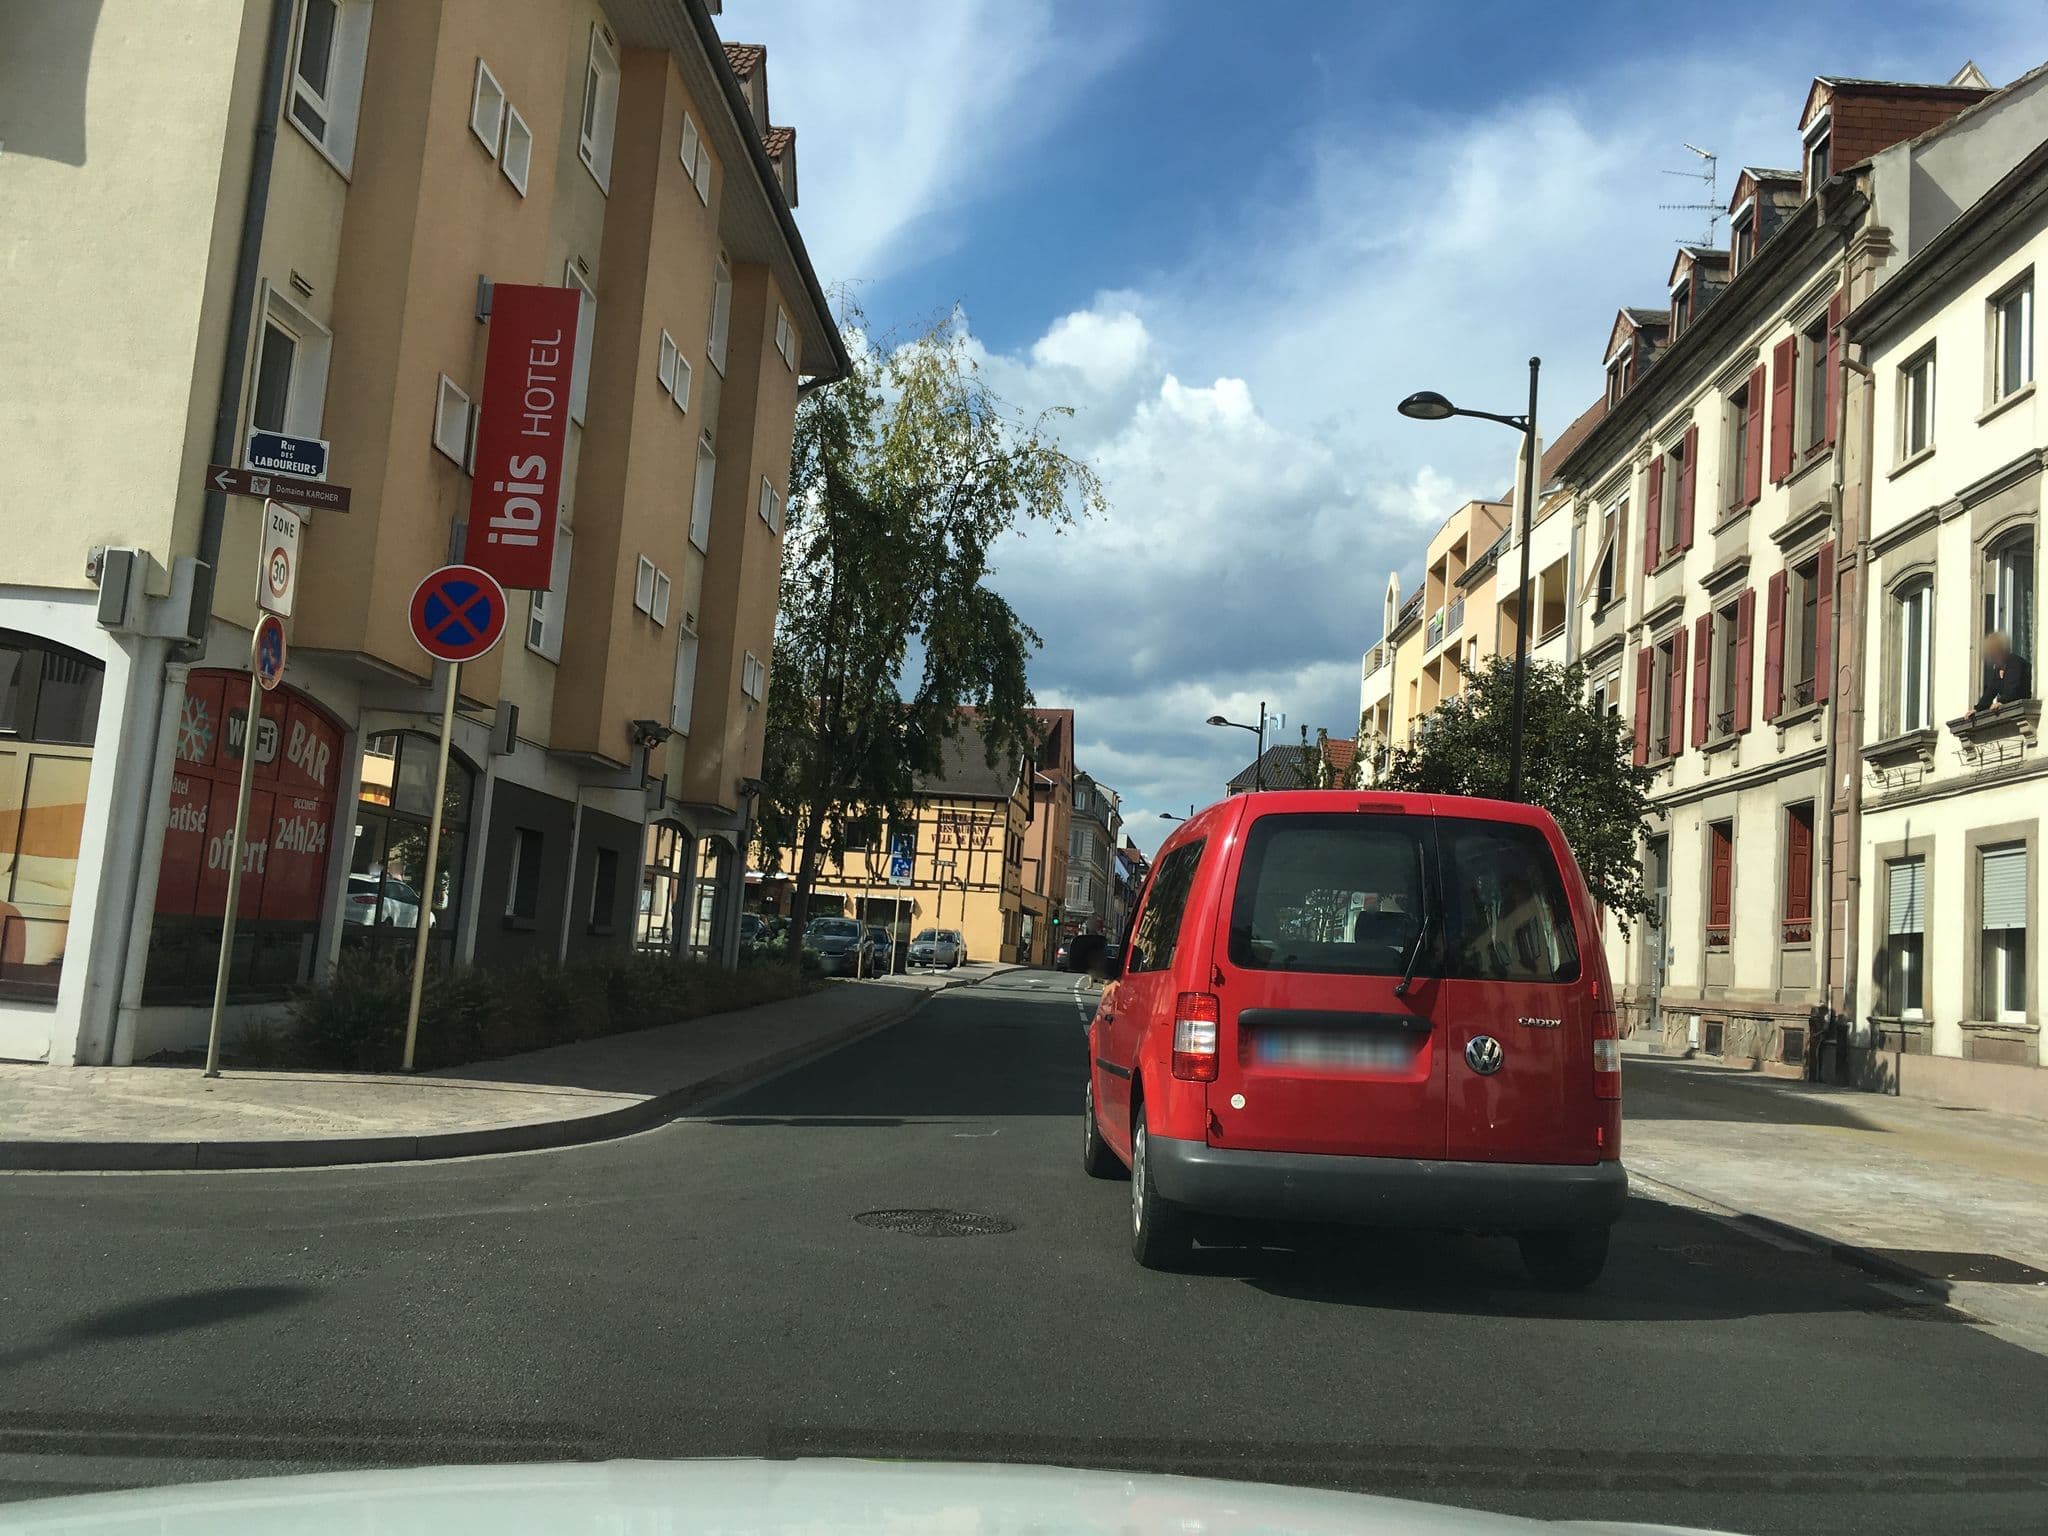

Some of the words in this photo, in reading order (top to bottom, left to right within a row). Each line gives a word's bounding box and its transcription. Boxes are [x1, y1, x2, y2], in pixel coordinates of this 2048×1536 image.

[487, 455, 547, 547] ibis
[521, 328, 562, 437] HOTEL
[255, 455, 317, 475] LABOUREURS
[276, 484, 304, 497] Domaine
[305, 489, 339, 502] KARCHER
[272, 515, 295, 539] ZONE
[272, 560, 286, 585] 30
[287, 720, 330, 787] BAR
[172, 777, 189, 795] ôtel
[168, 802, 207, 832] atisé
[208, 828, 268, 874] ofert
[1518, 1017, 1562, 1029] CADDY
